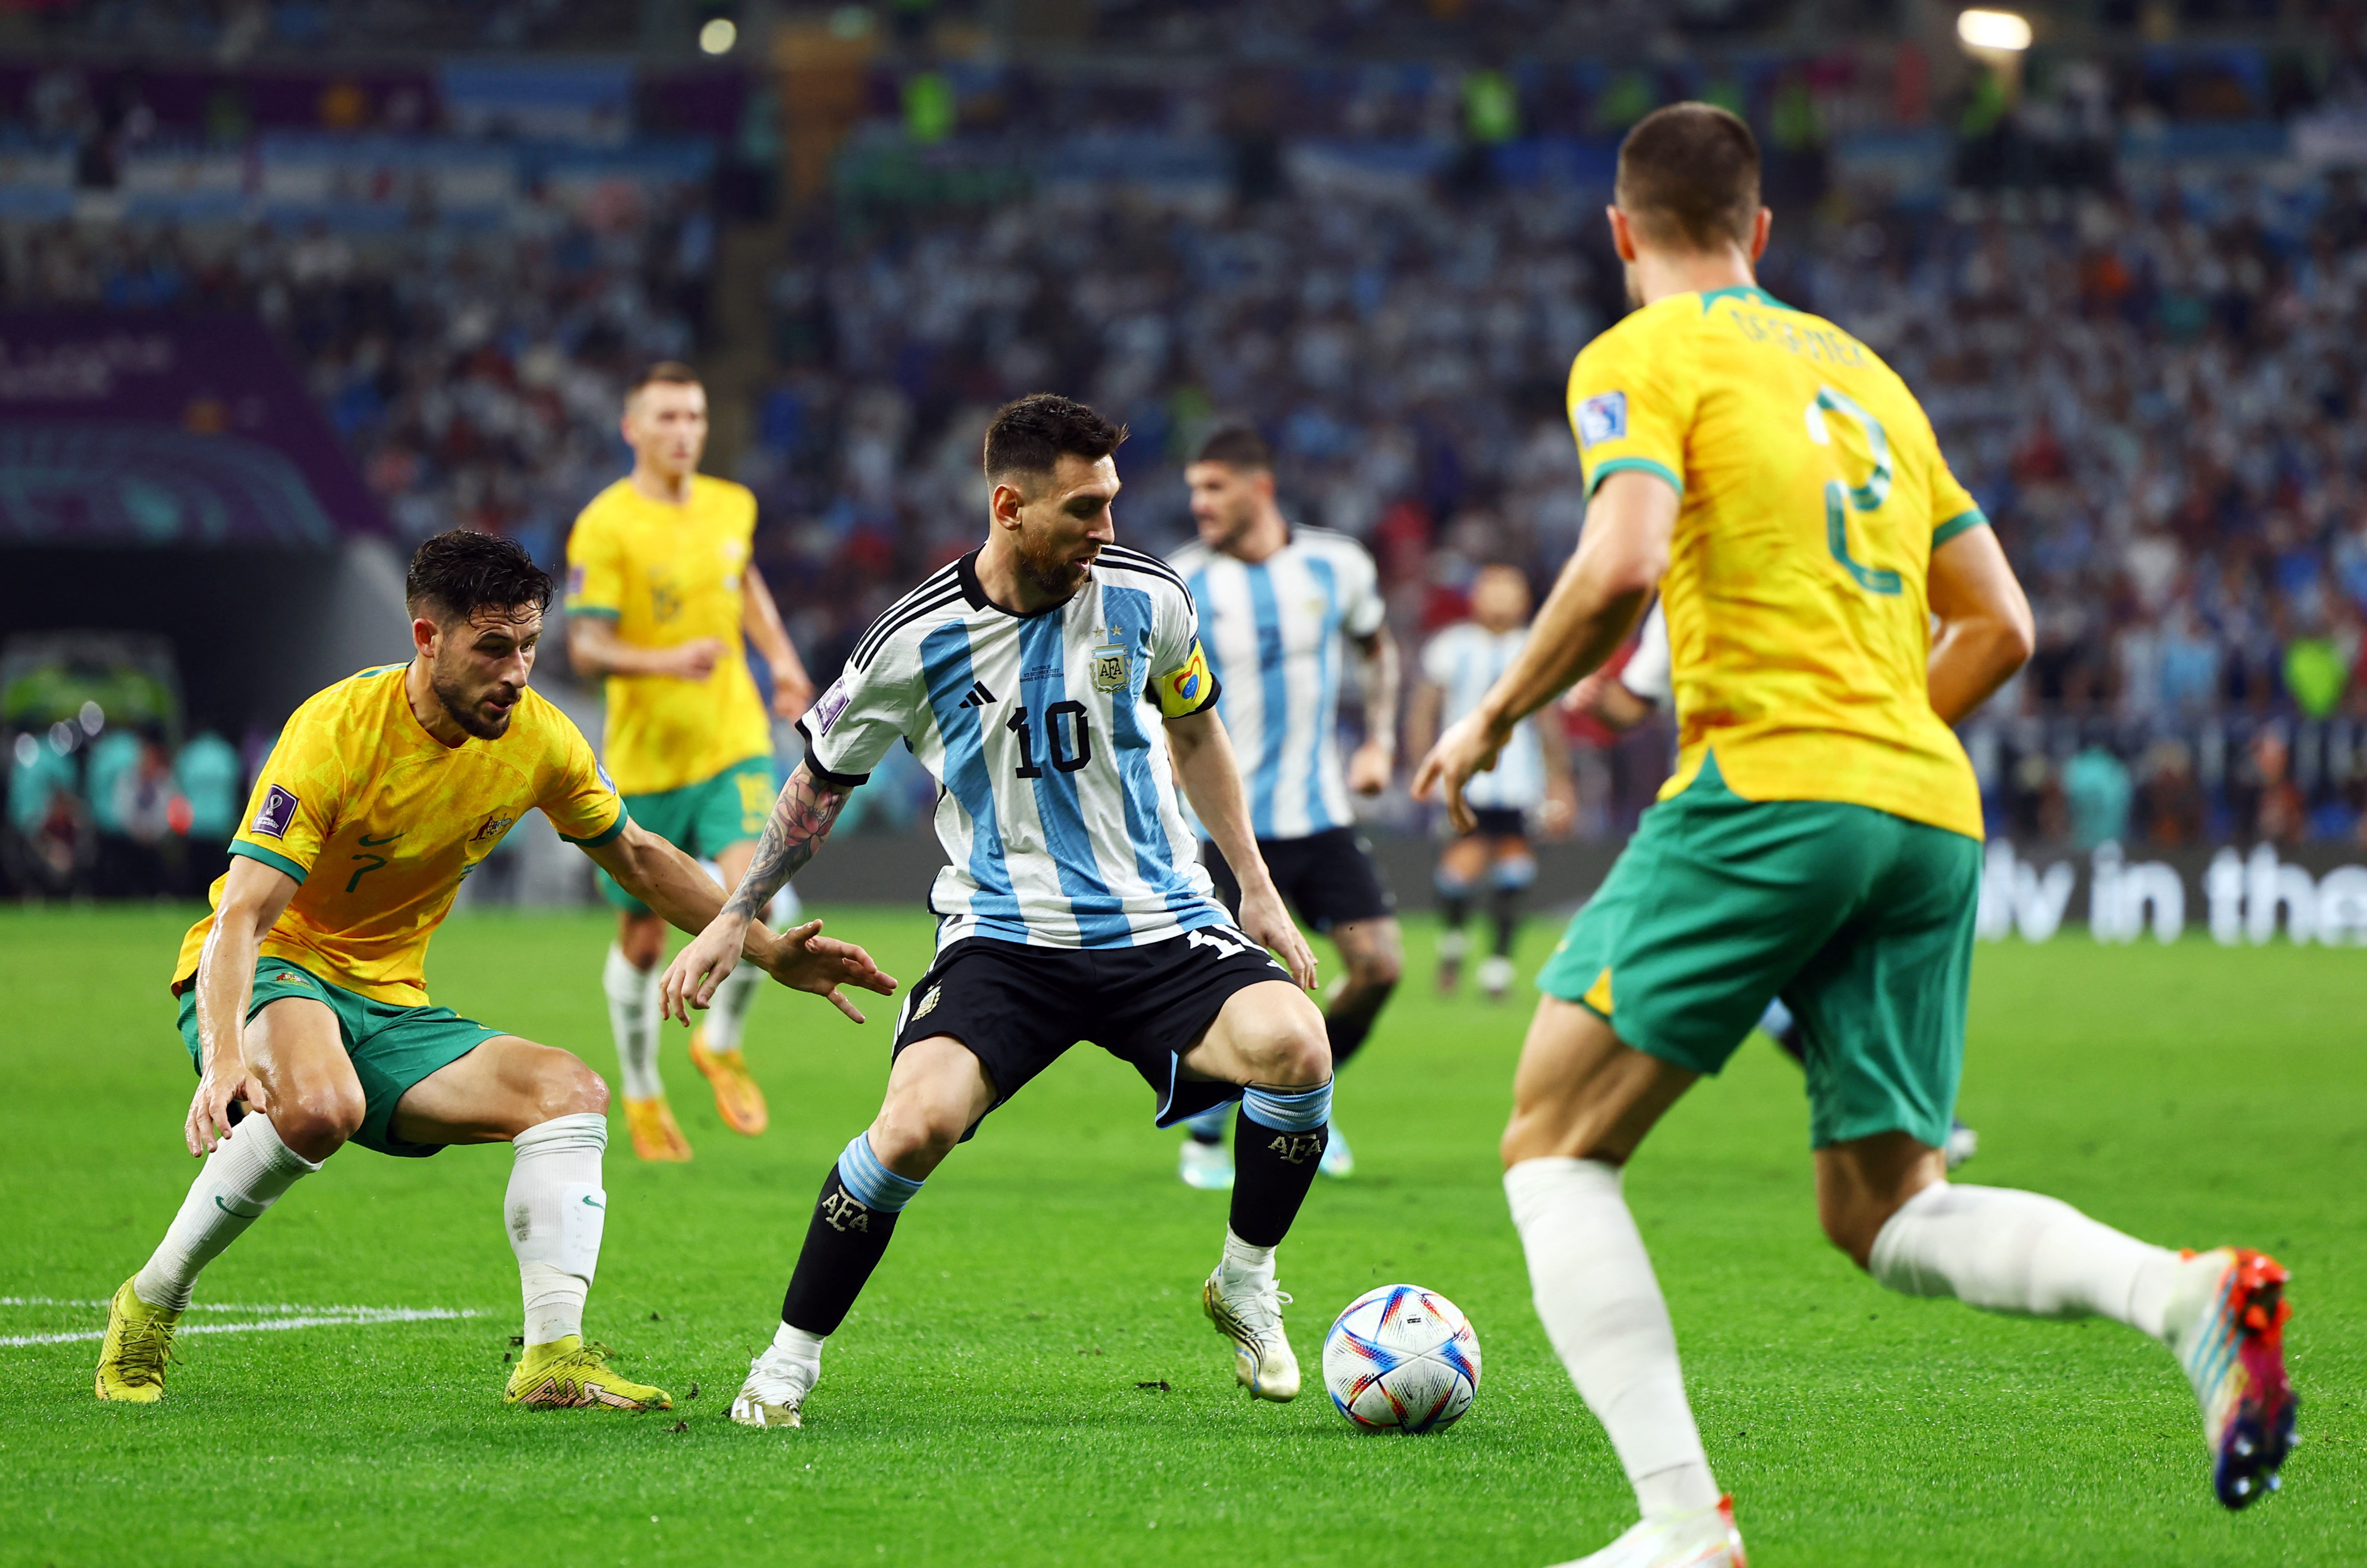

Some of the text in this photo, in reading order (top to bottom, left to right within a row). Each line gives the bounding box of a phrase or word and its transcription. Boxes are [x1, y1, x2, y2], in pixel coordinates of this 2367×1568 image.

[1804, 384, 1902, 595] 2
[1100, 657, 1122, 680] AFA
[1006, 700, 1091, 779] 10
[345, 854, 388, 893] 7
[2088, 838, 2185, 946] in
[1268, 1131, 1321, 1164] AFA
[822, 1184, 867, 1232] AFA
